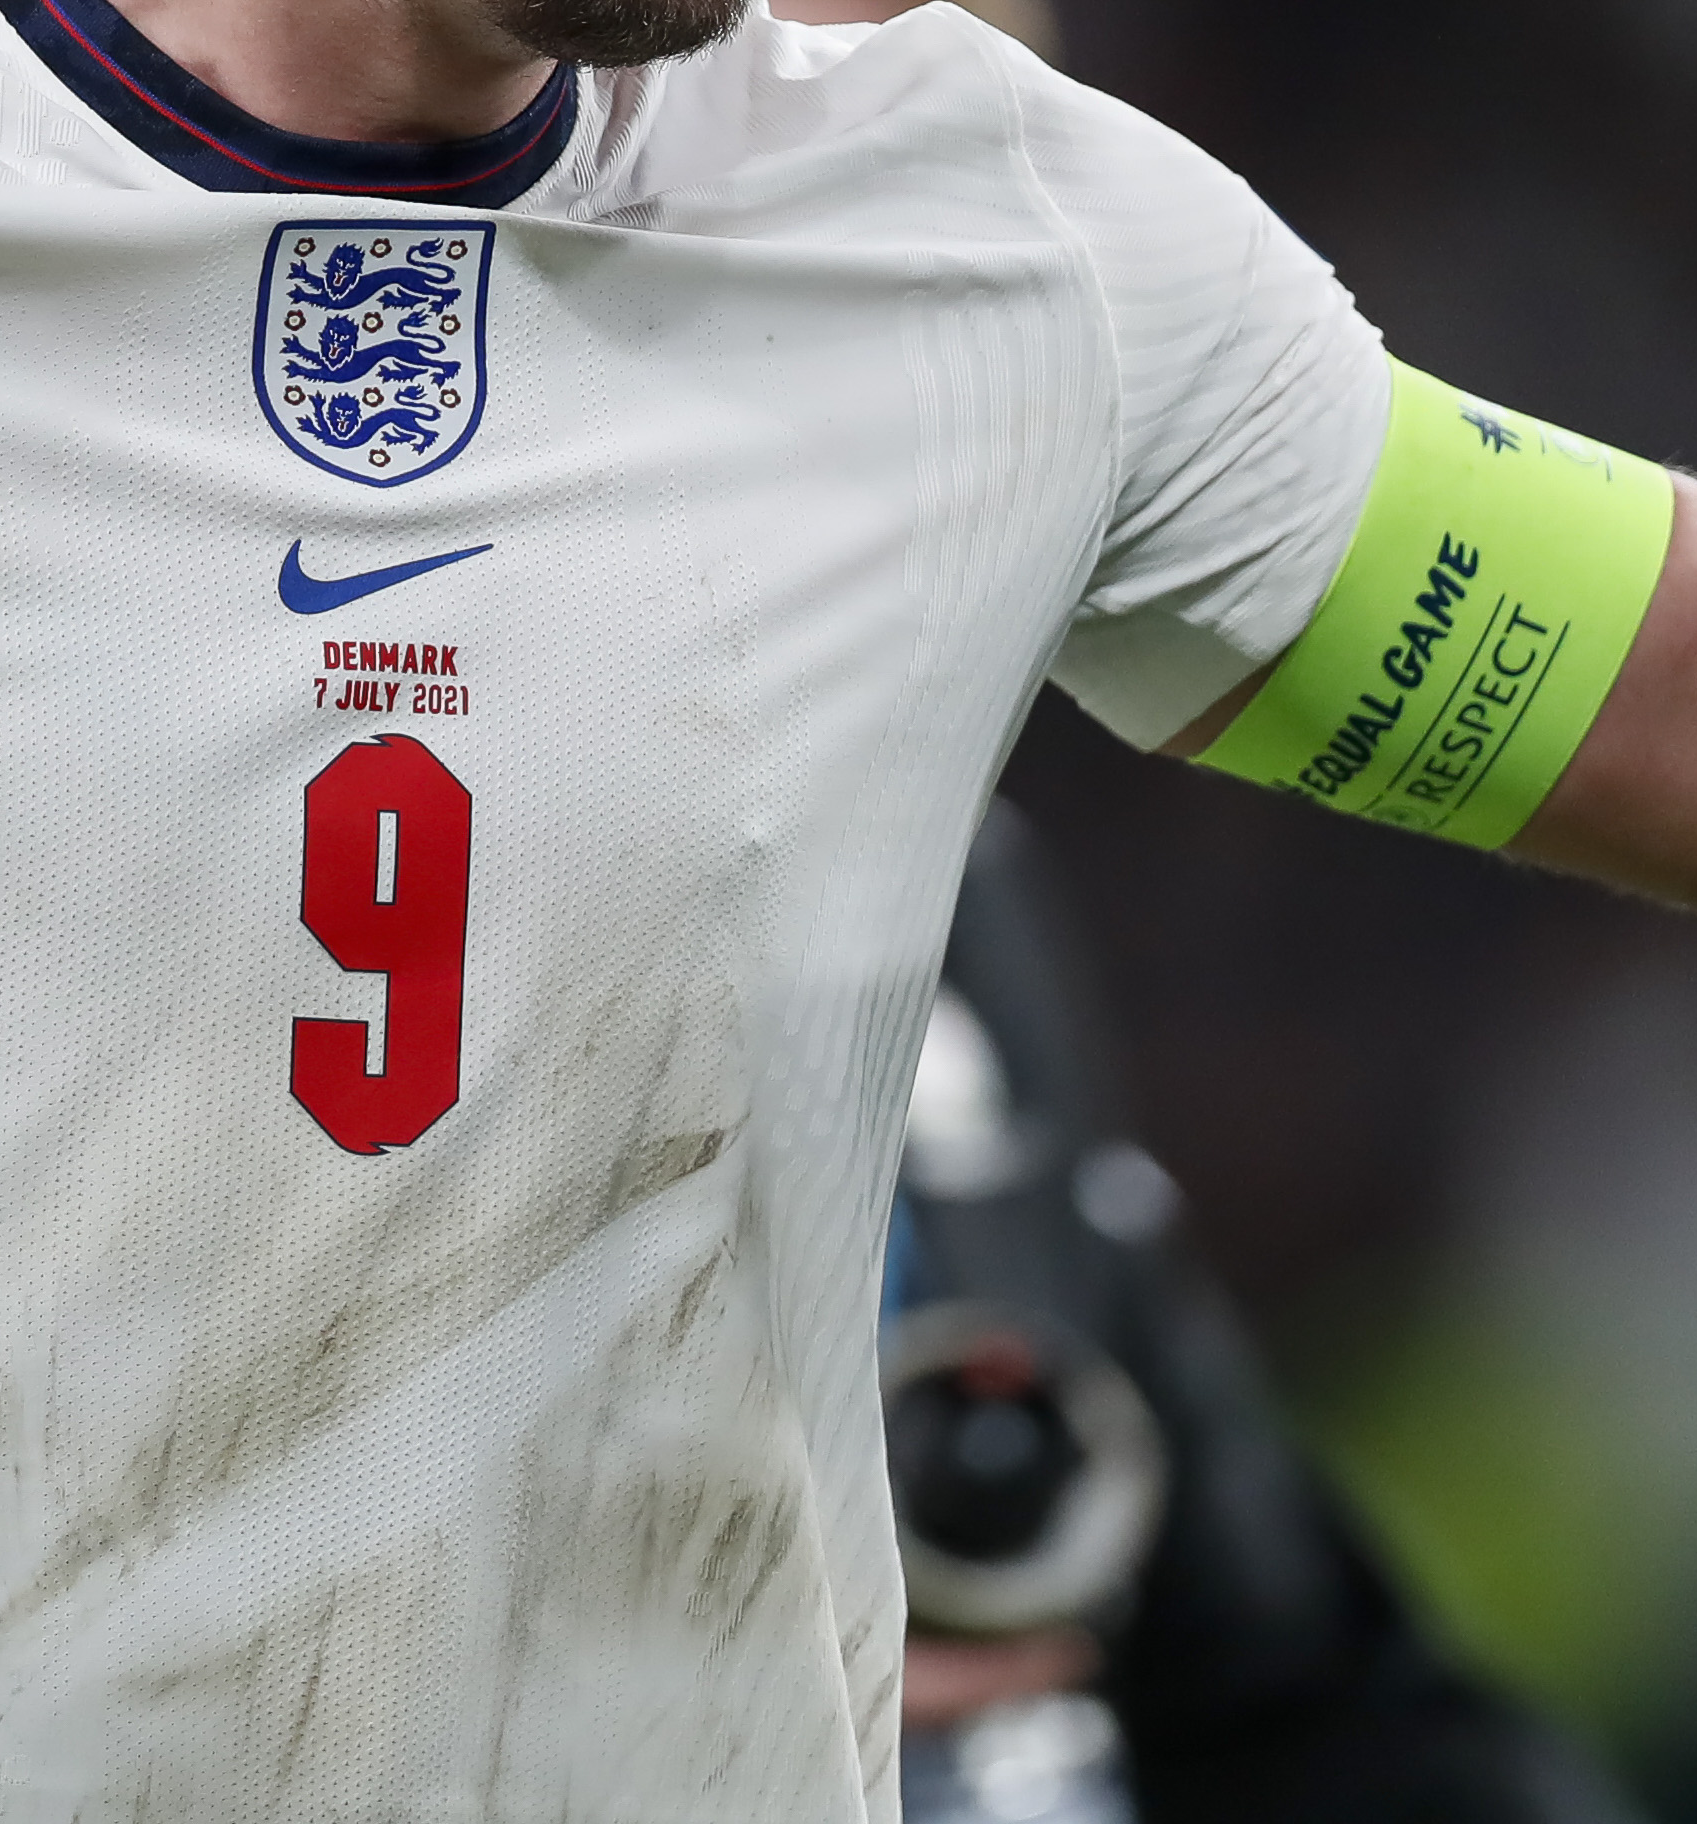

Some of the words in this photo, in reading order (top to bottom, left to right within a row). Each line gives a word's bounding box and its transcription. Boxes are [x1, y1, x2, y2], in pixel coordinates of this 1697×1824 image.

[314, 678, 328, 708] 7
[336, 679, 400, 712] JULY
[413, 683, 468, 715] 2021
[323, 641, 458, 676] DENMARK
[1407, 602, 1548, 803] RESPECT
[290, 734, 472, 1155] 9
